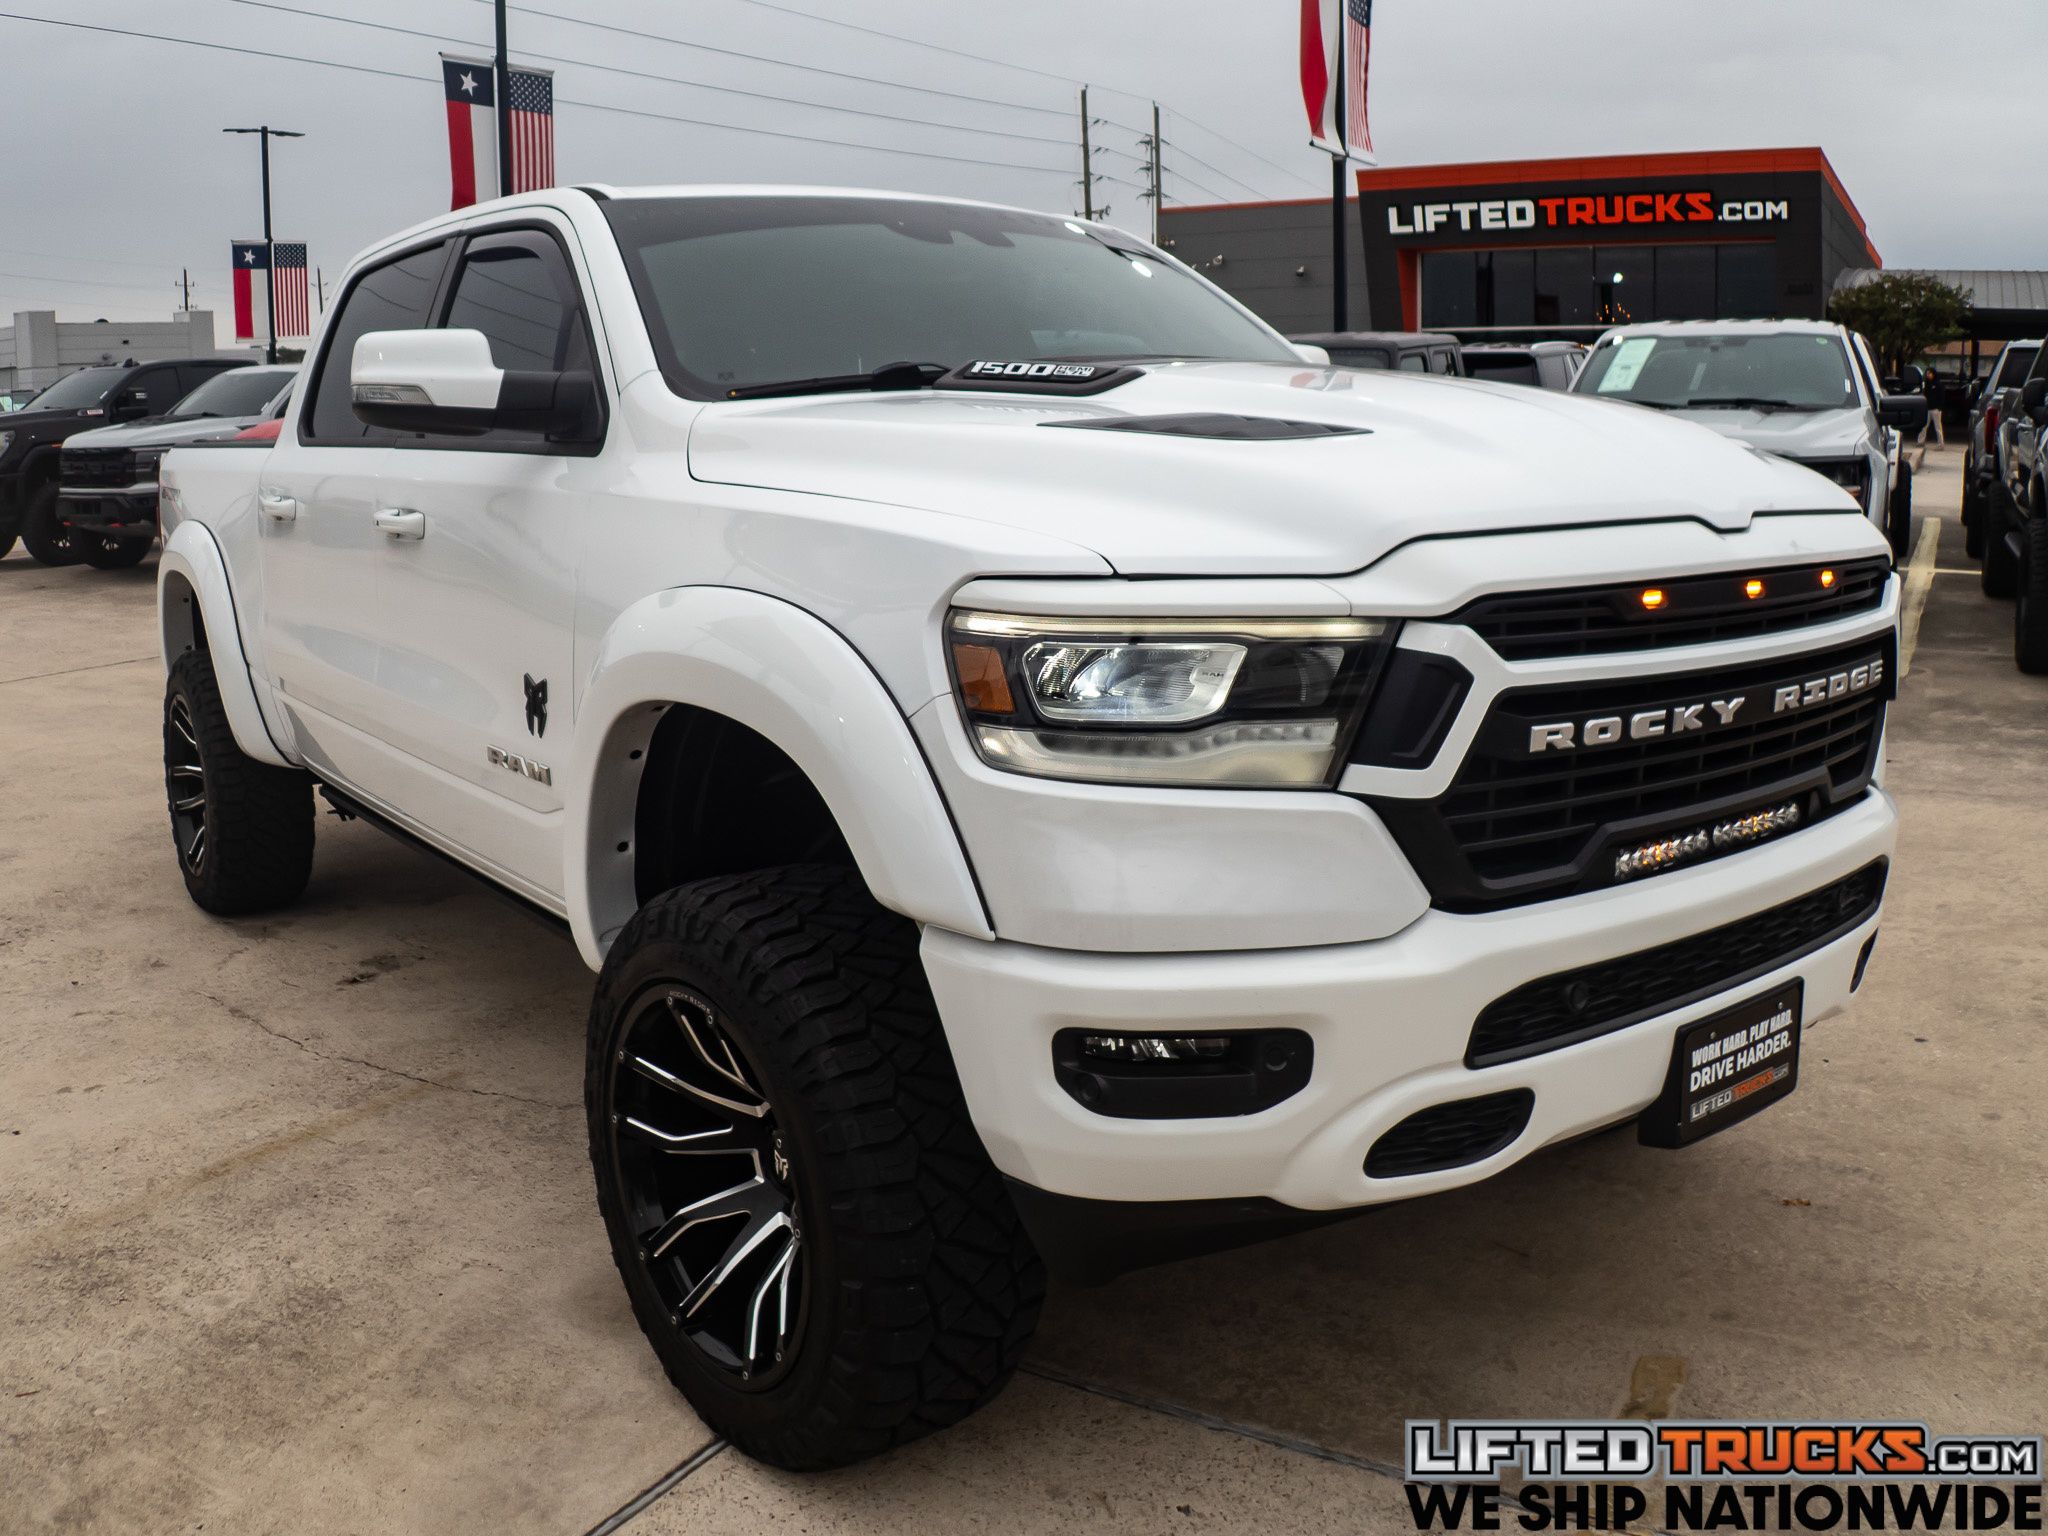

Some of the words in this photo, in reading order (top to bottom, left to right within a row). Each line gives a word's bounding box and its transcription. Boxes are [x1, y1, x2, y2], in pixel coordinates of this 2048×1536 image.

[970, 361, 1057, 377] 1500
[1529, 696, 1745, 754] ROCKY
[1773, 658, 1884, 714] RIDGE
[487, 744, 552, 787] RAM
[1690, 1055, 1734, 1092] DRIVE
[1736, 1030, 1792, 1072] HARDER.
[1691, 1039, 1722, 1068] WORK
[1722, 1029, 1748, 1055] HARD.
[1750, 1019, 1770, 1044] PLAY
[1770, 1010, 1792, 1032] HARD.
